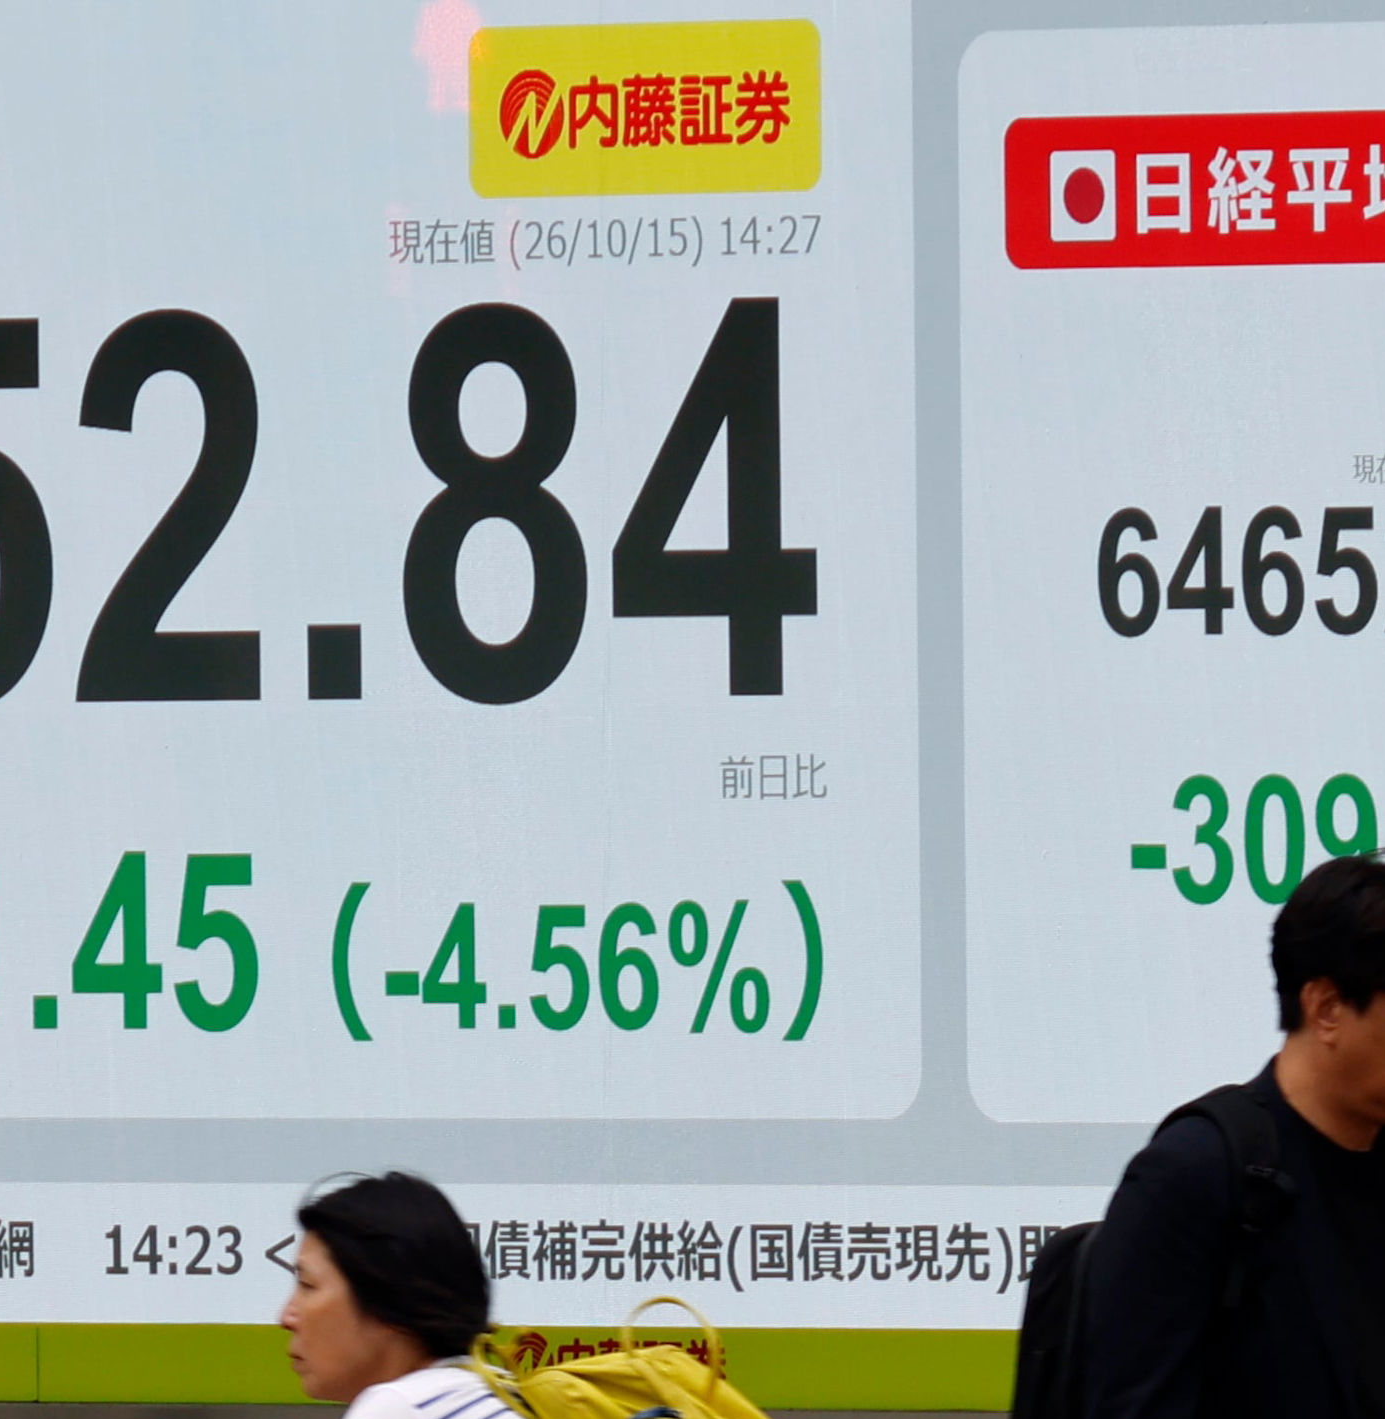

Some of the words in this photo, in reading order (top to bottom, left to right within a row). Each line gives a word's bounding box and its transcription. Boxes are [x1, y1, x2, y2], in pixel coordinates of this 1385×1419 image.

[567, 70, 791, 150] 内藤証券
[389, 218, 496, 265] 現在値
[509, 215, 703, 271] (26/10/15)
[720, 214, 822, 256] 14:27
[719, 753, 828, 801] 前日比
[331, 881, 825, 1042] (-4.56%)
[105, 1224, 243, 1276] 14:23
[466, 1220, 1064, 1294] 債補完供給(国債売現先)
